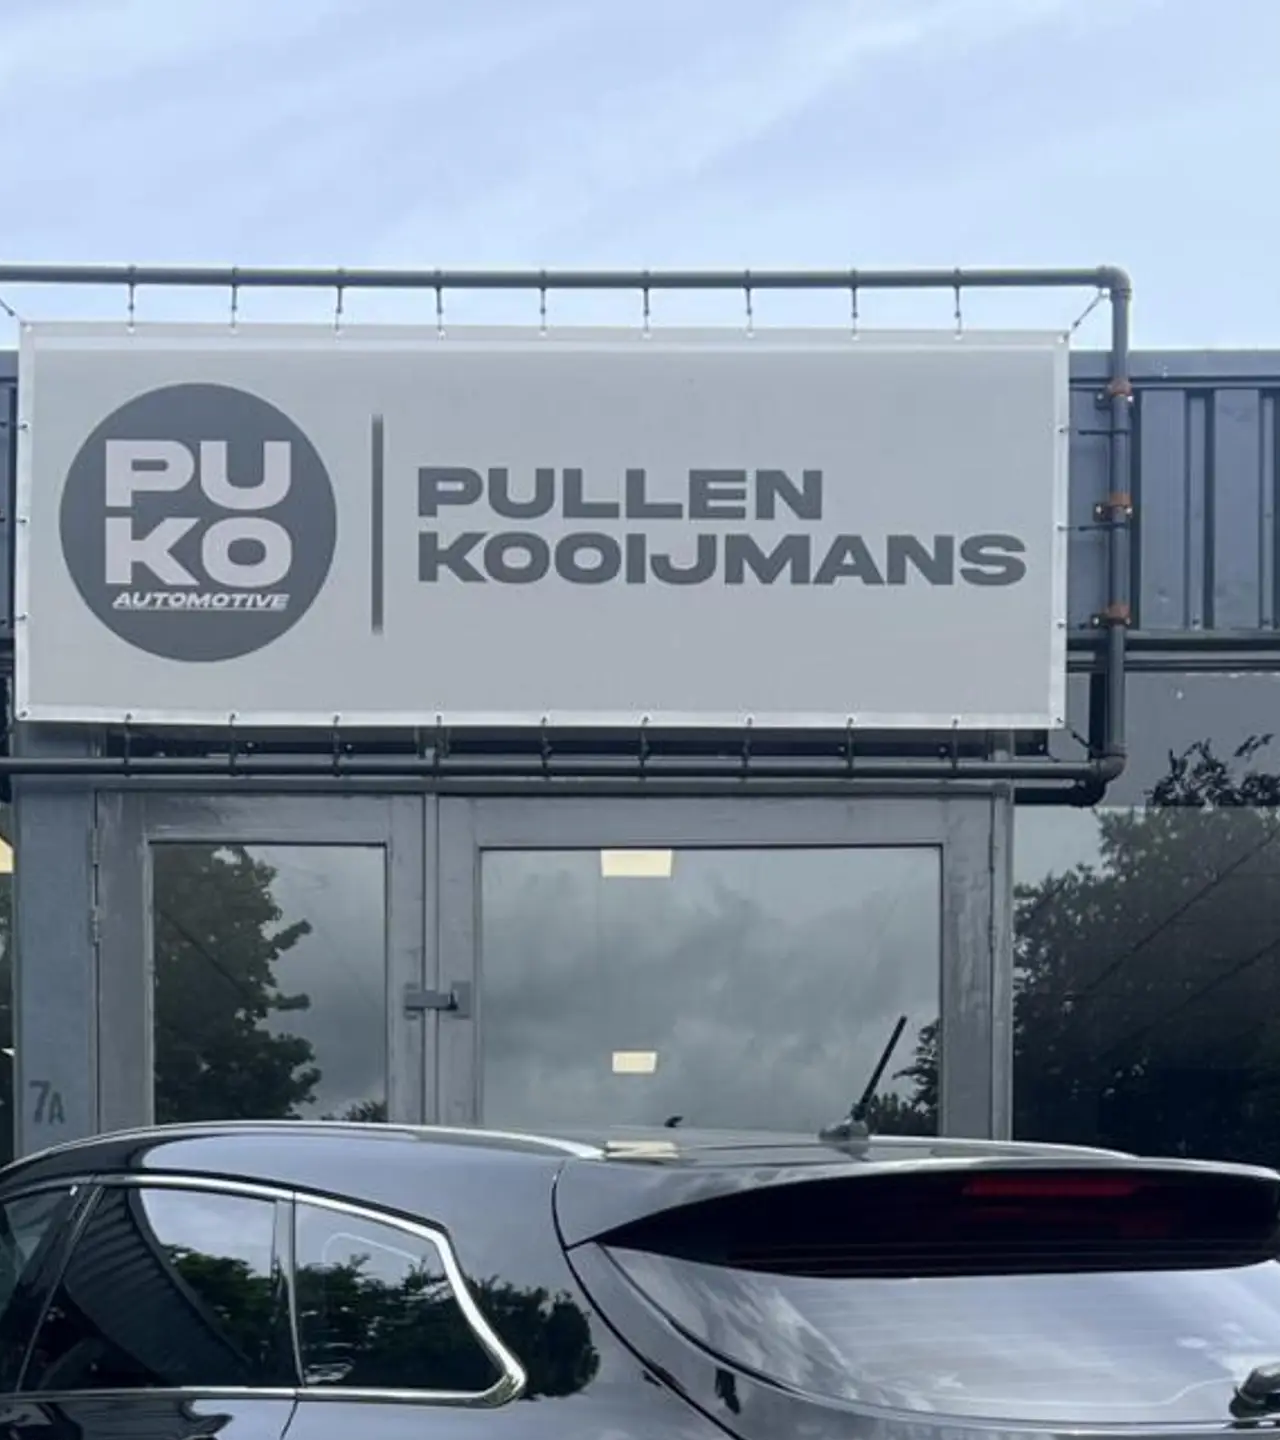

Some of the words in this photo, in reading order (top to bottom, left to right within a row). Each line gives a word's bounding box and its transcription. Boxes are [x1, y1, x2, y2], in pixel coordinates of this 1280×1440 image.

[105, 439, 292, 511] PU
[417, 465, 823, 521] PULLEN
[105, 516, 293, 588] KO
[417, 530, 1028, 587] KOOIJMANS
[112, 591, 291, 611] AUTOMOTIVE
[28, 1080, 66, 1125] 7A
